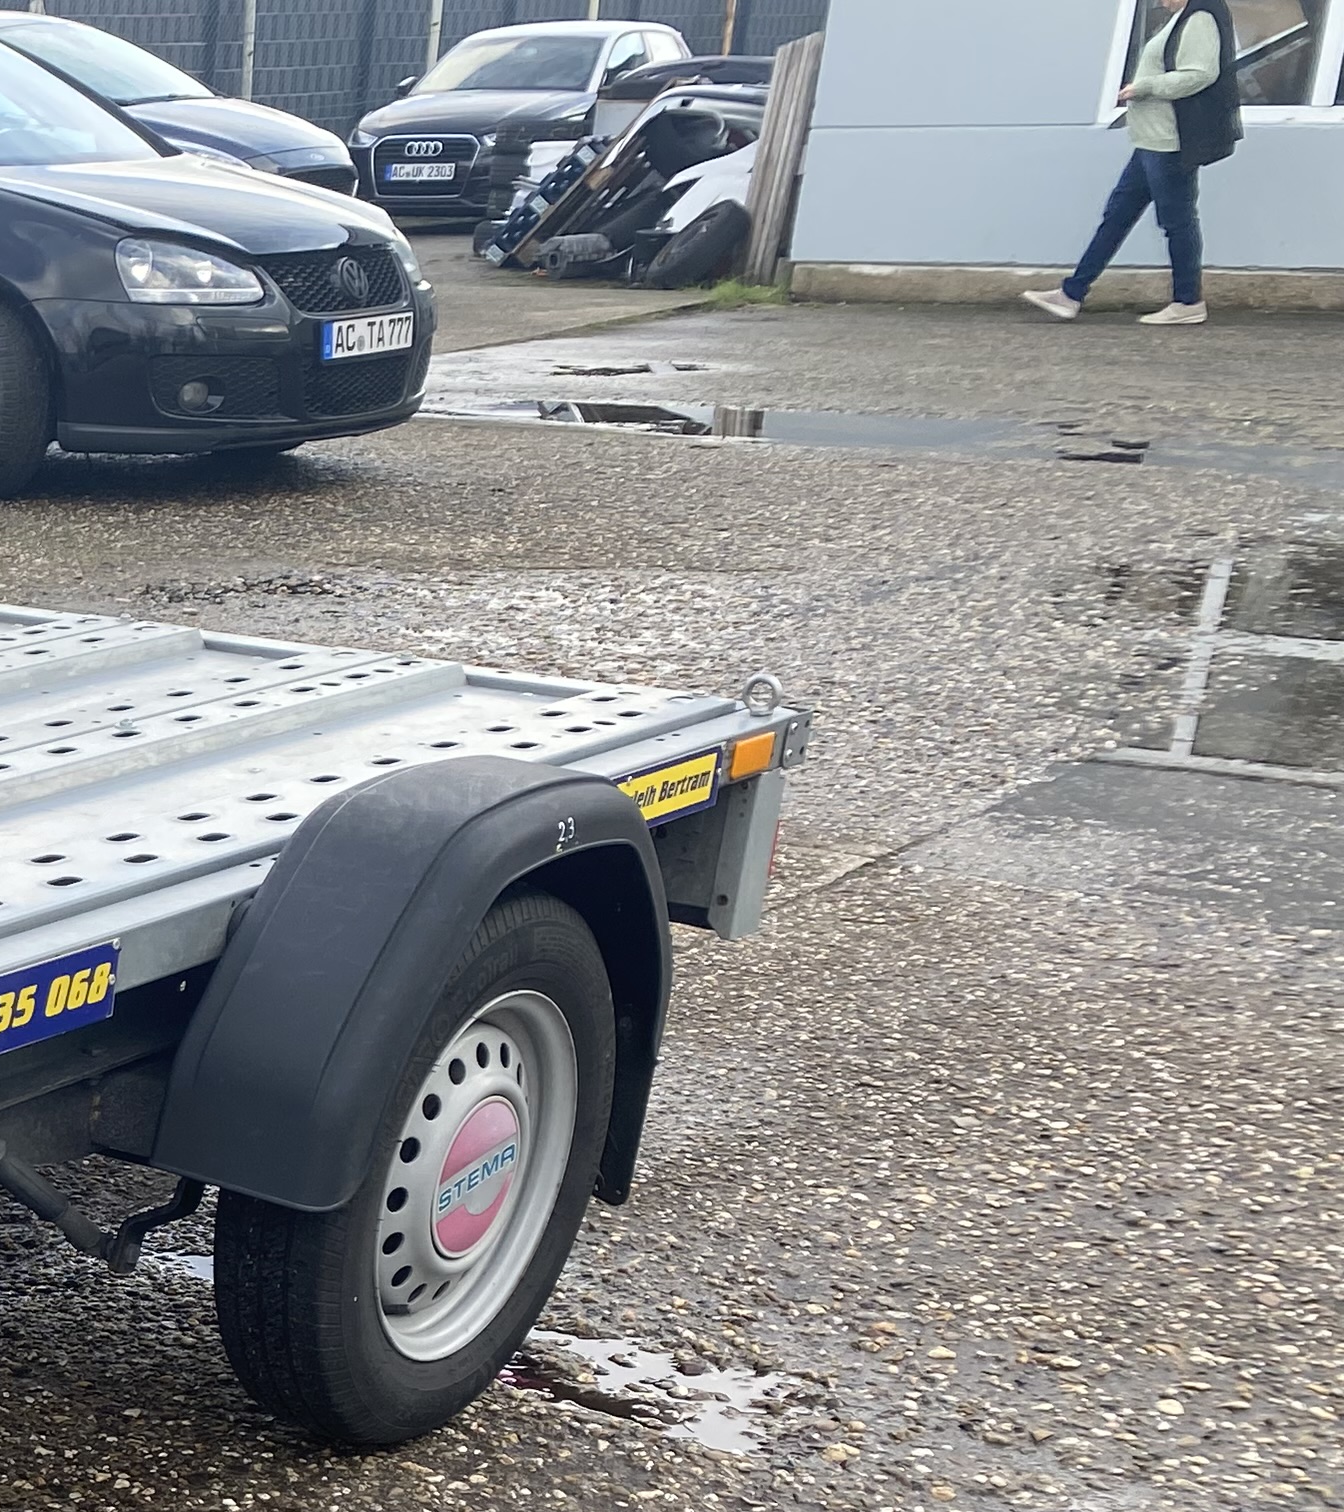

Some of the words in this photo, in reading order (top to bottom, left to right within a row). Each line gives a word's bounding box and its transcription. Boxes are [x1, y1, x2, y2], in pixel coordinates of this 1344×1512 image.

[392, 166, 405, 178] AC
[427, 165, 454, 178] 2303
[335, 324, 356, 354] AC
[658, 770, 712, 802] Bertram
[45, 962, 111, 1017] 068
[438, 1144, 516, 1213] STEMA
